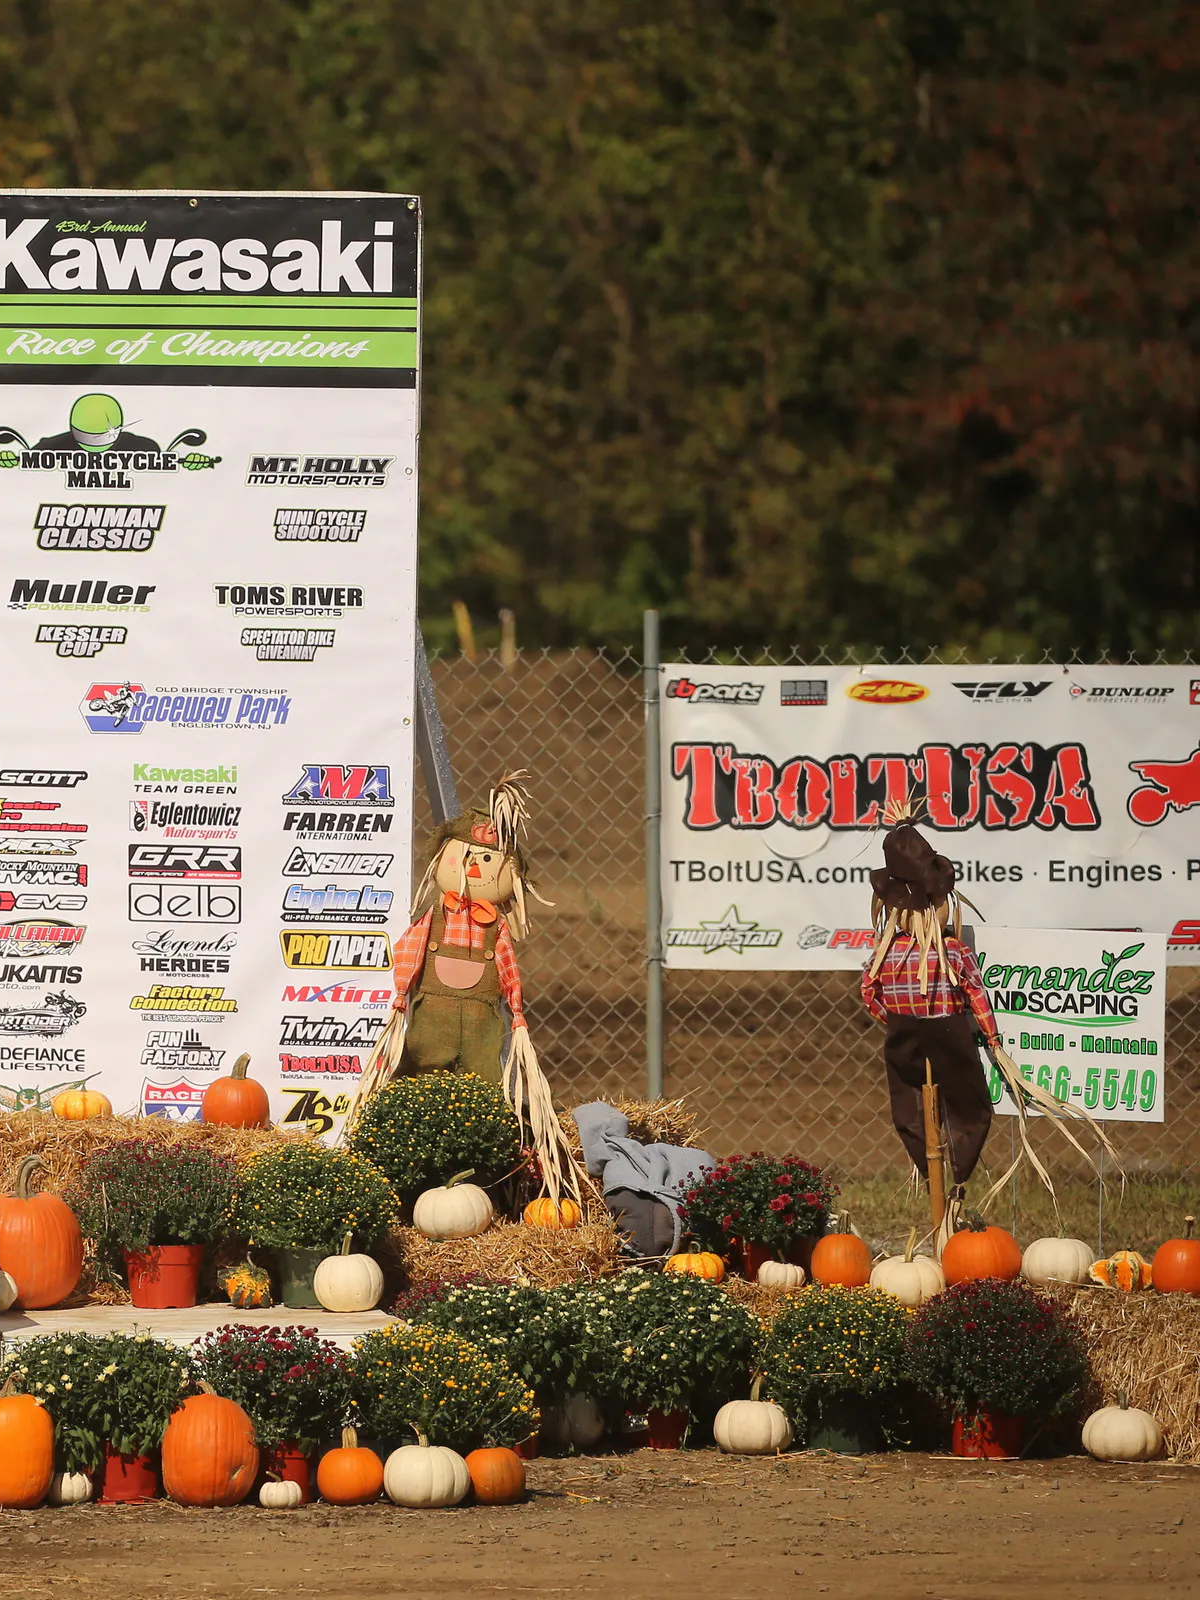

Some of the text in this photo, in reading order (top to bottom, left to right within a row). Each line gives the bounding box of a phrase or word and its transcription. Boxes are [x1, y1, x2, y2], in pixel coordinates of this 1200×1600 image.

[56, 220, 146, 233] 43rd Annual
[6, 331, 370, 364] Race of Champions
[22, 452, 176, 470] MOTORCYCLE
[67, 471, 131, 488] MALL
[38, 507, 162, 528] IRONMAN
[41, 529, 152, 548] CLASSIC
[9, 580, 156, 604] Muller
[215, 585, 363, 607] TOMS RIVER
[852, 684, 924, 699] FMF
[1089, 687, 1175, 697] DUNLOP
[129, 694, 291, 725] Raceway Park
[283, 813, 393, 831] FARREN
[670, 860, 873, 884] TBoltUSA.com
[1049, 861, 1162, 887] Engines
[978, 952, 1155, 994] ernandez
[987, 990, 1138, 1017] NDSCAPING
[1, 1048, 85, 1061] DEFIANCE
[1020, 1032, 1064, 1051] Build
[1081, 1035, 1158, 1056] Maintain
